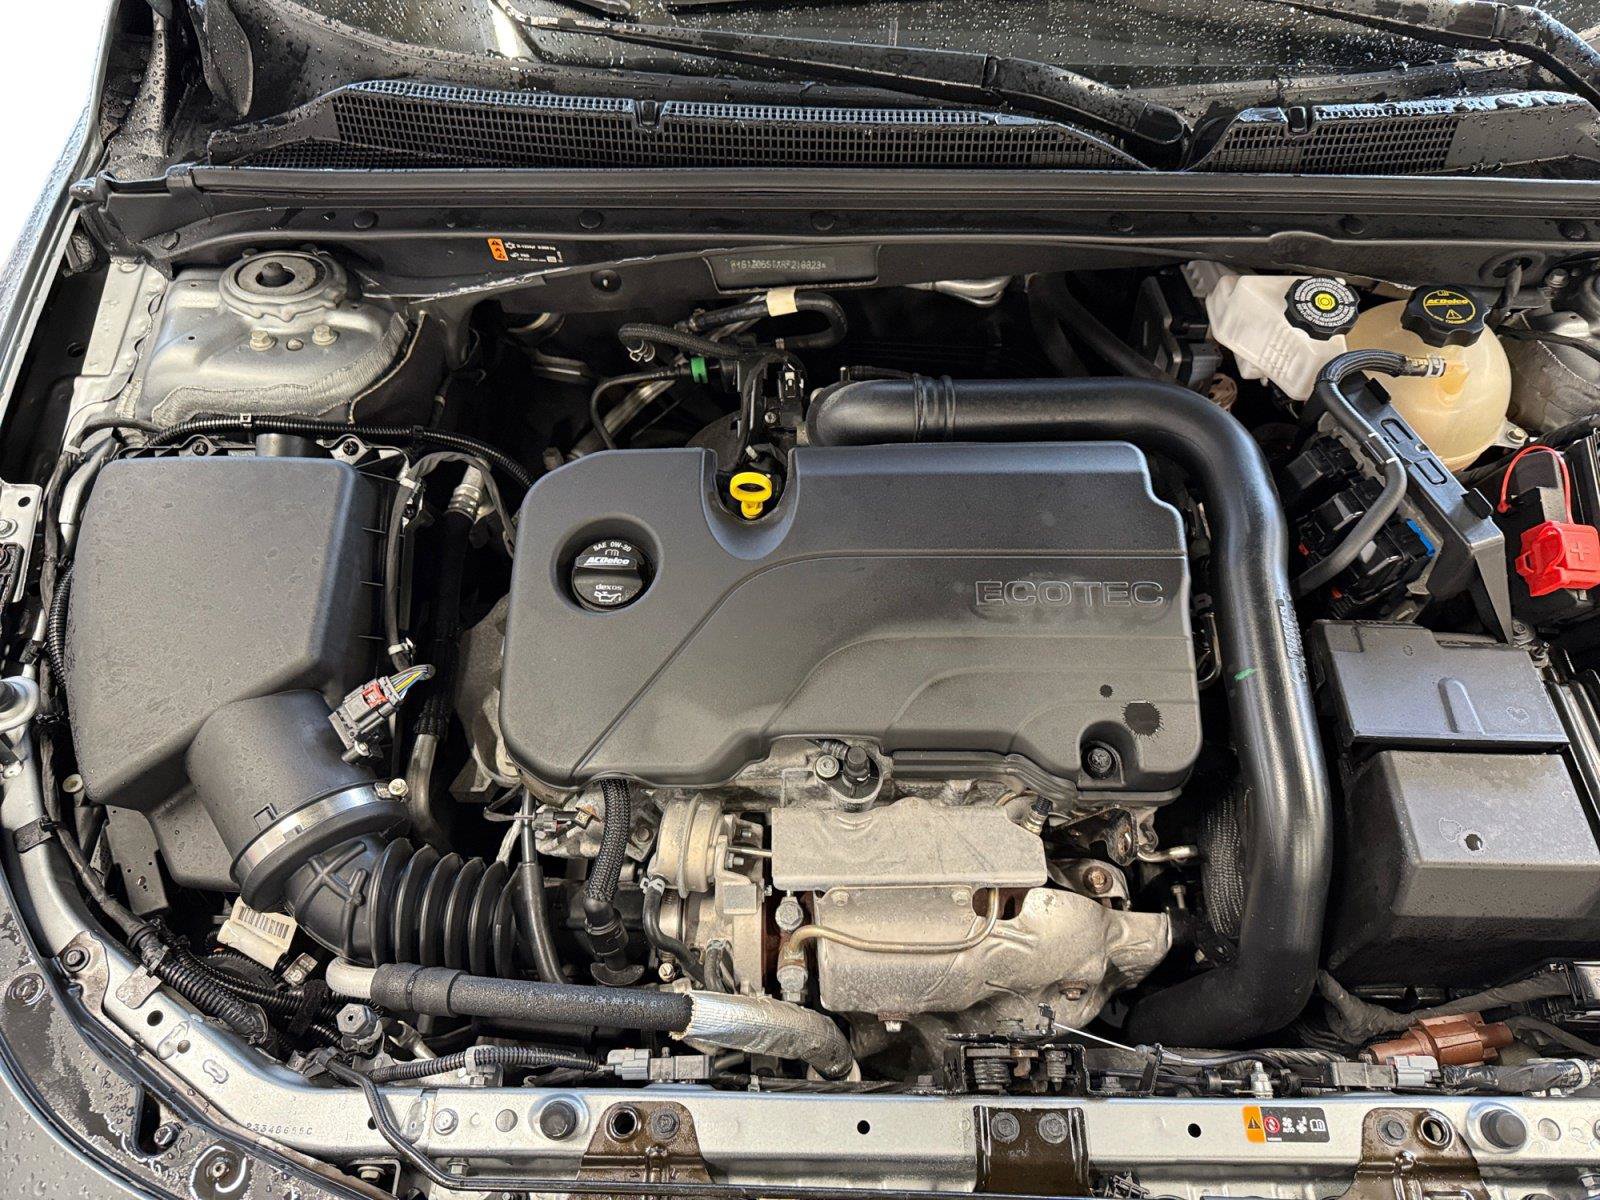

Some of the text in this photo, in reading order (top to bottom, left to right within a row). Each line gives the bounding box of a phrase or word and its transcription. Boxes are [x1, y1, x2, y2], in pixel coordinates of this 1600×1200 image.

[593, 541, 632, 553] SAE 0W-20
[583, 556, 630, 567] ACDelco
[595, 583, 623, 591] dexos
[974, 580, 1165, 608] ECOTEC
